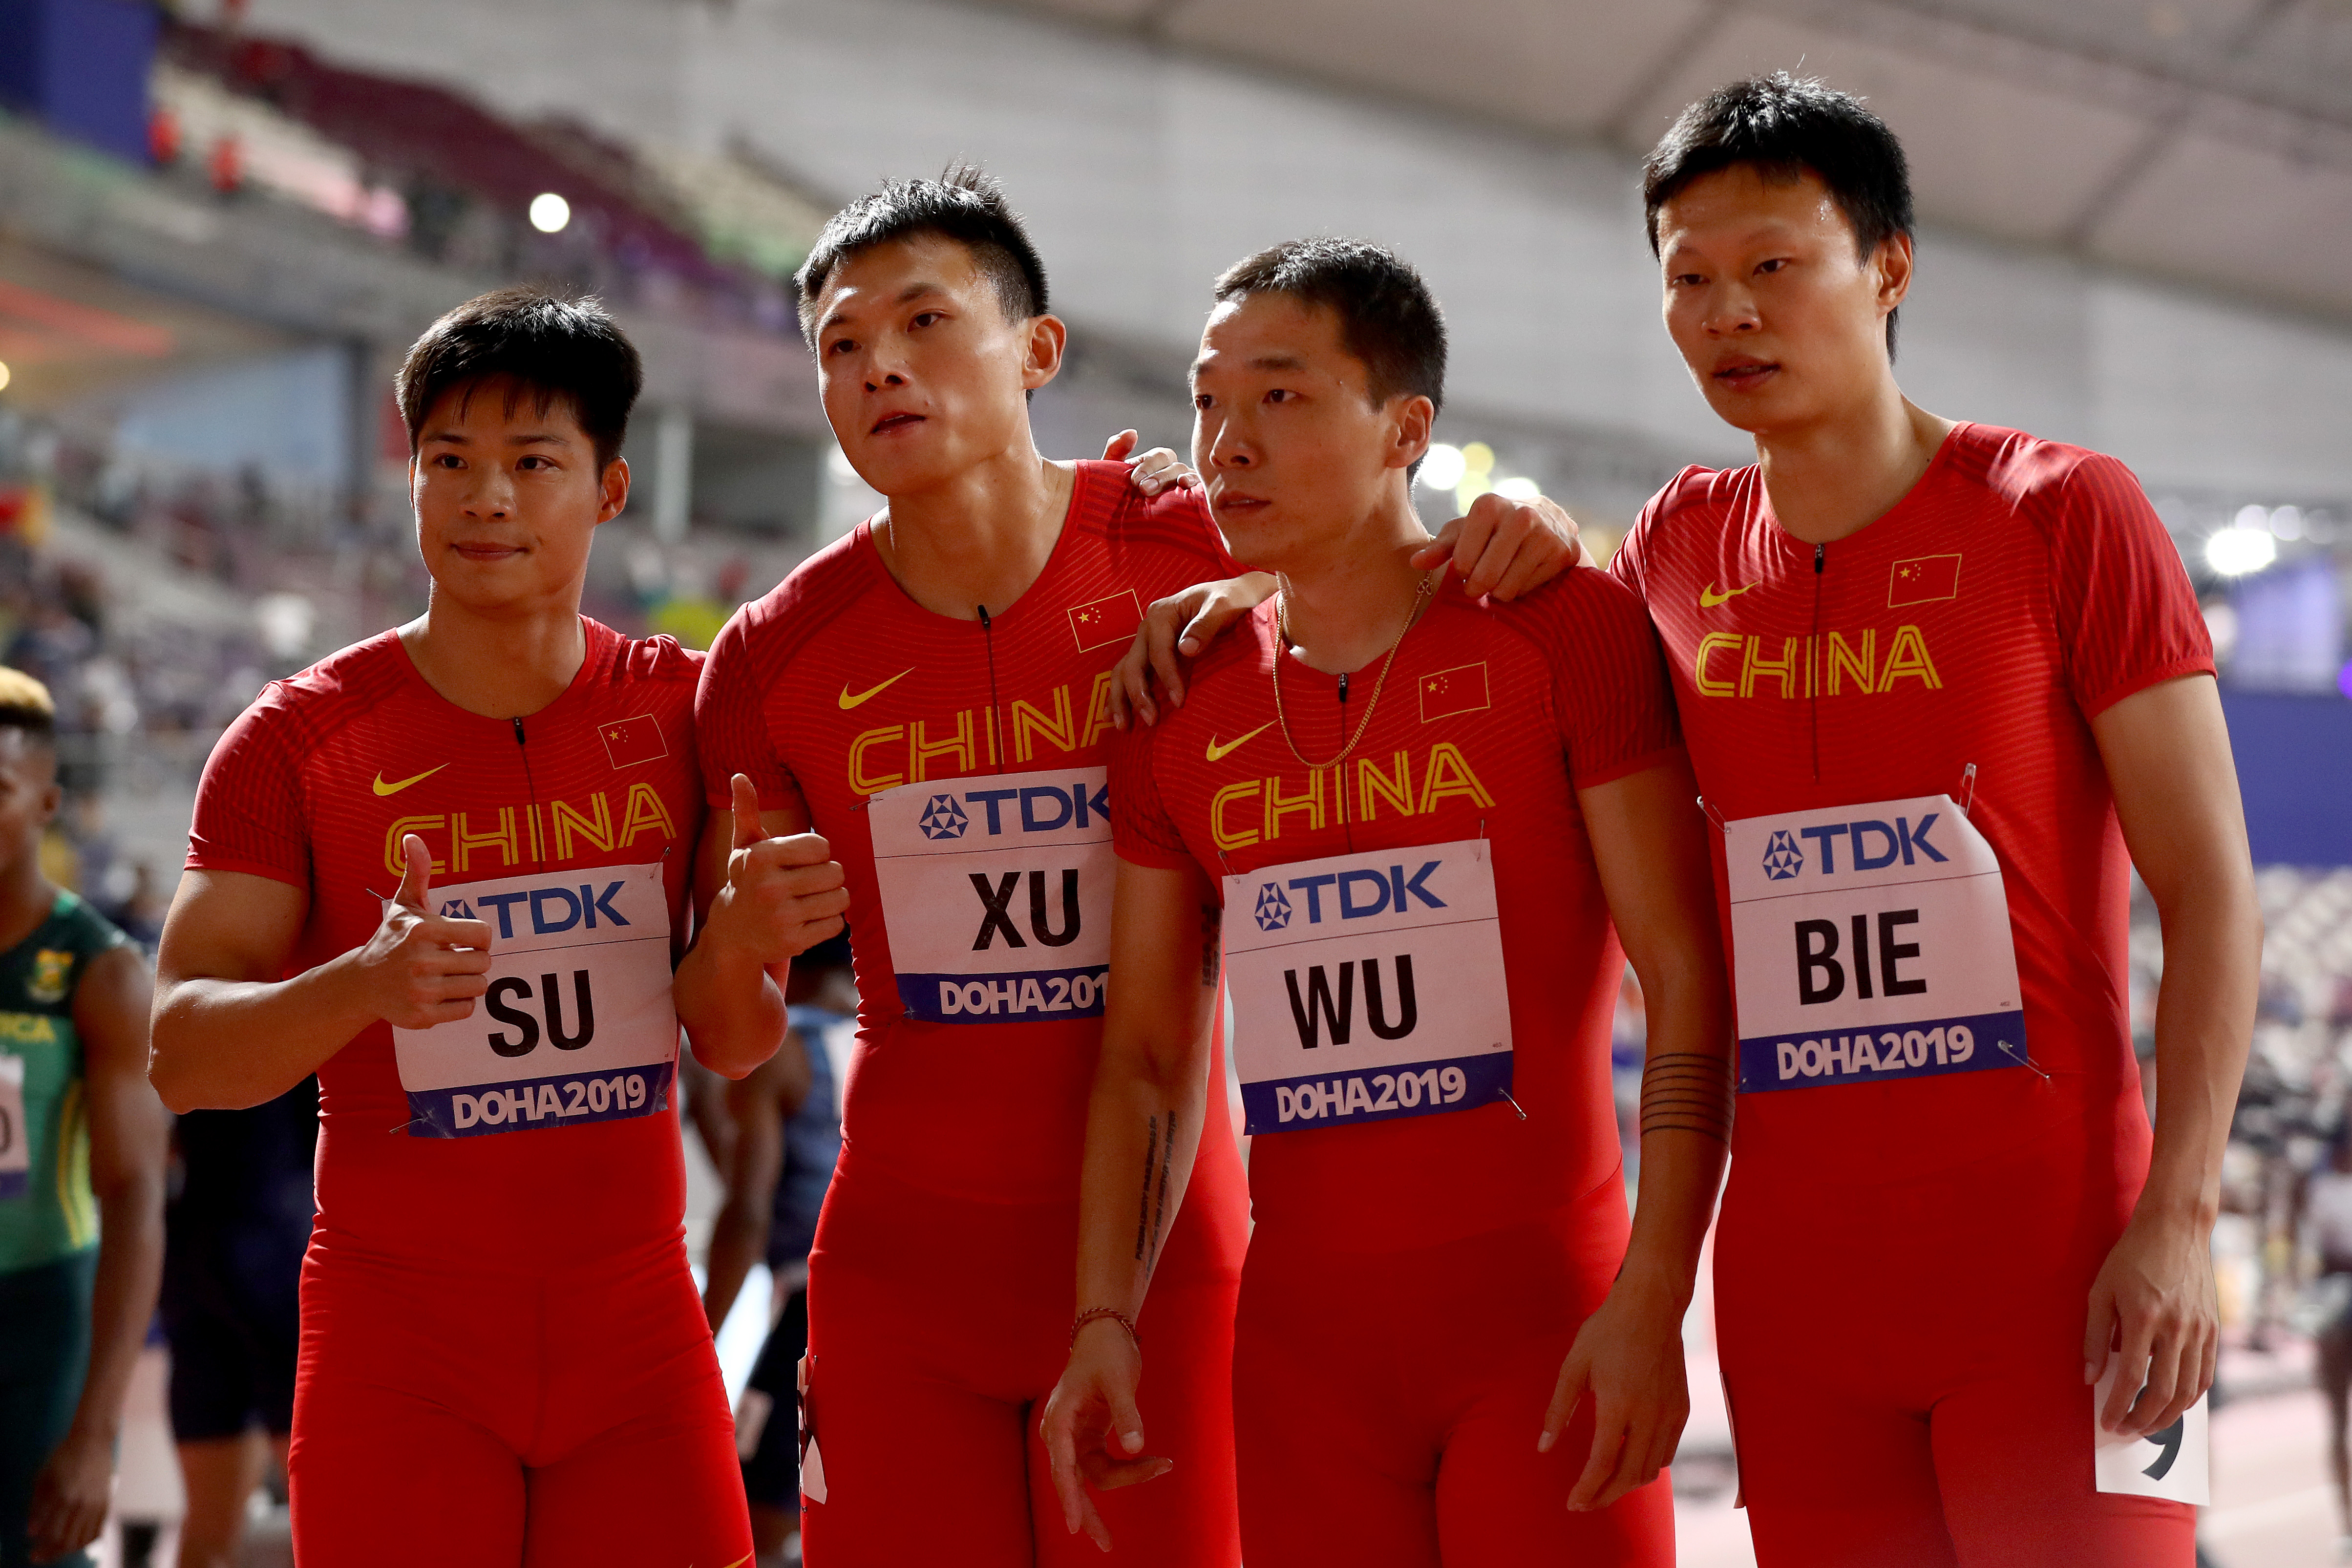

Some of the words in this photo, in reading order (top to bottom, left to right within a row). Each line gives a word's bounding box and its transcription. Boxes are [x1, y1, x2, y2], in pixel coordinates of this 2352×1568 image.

[1695, 625, 1943, 699] CHINA
[384, 783, 678, 877] CHINA
[966, 783, 1111, 835] TDK
[1211, 742, 1496, 851] CHINA
[1801, 813, 1949, 874] TDK
[477, 881, 631, 939] TDK
[968, 869, 1081, 951] XU
[1289, 860, 1448, 924] TDK
[1794, 909, 1927, 1006] BIE
[485, 969, 595, 1058] SU
[1284, 954, 1418, 1050] WU
[1777, 1025, 1975, 1081] DOHA2019
[452, 1074, 646, 1129] DOHA2019
[1275, 1066, 1466, 1123] DOHA2019
